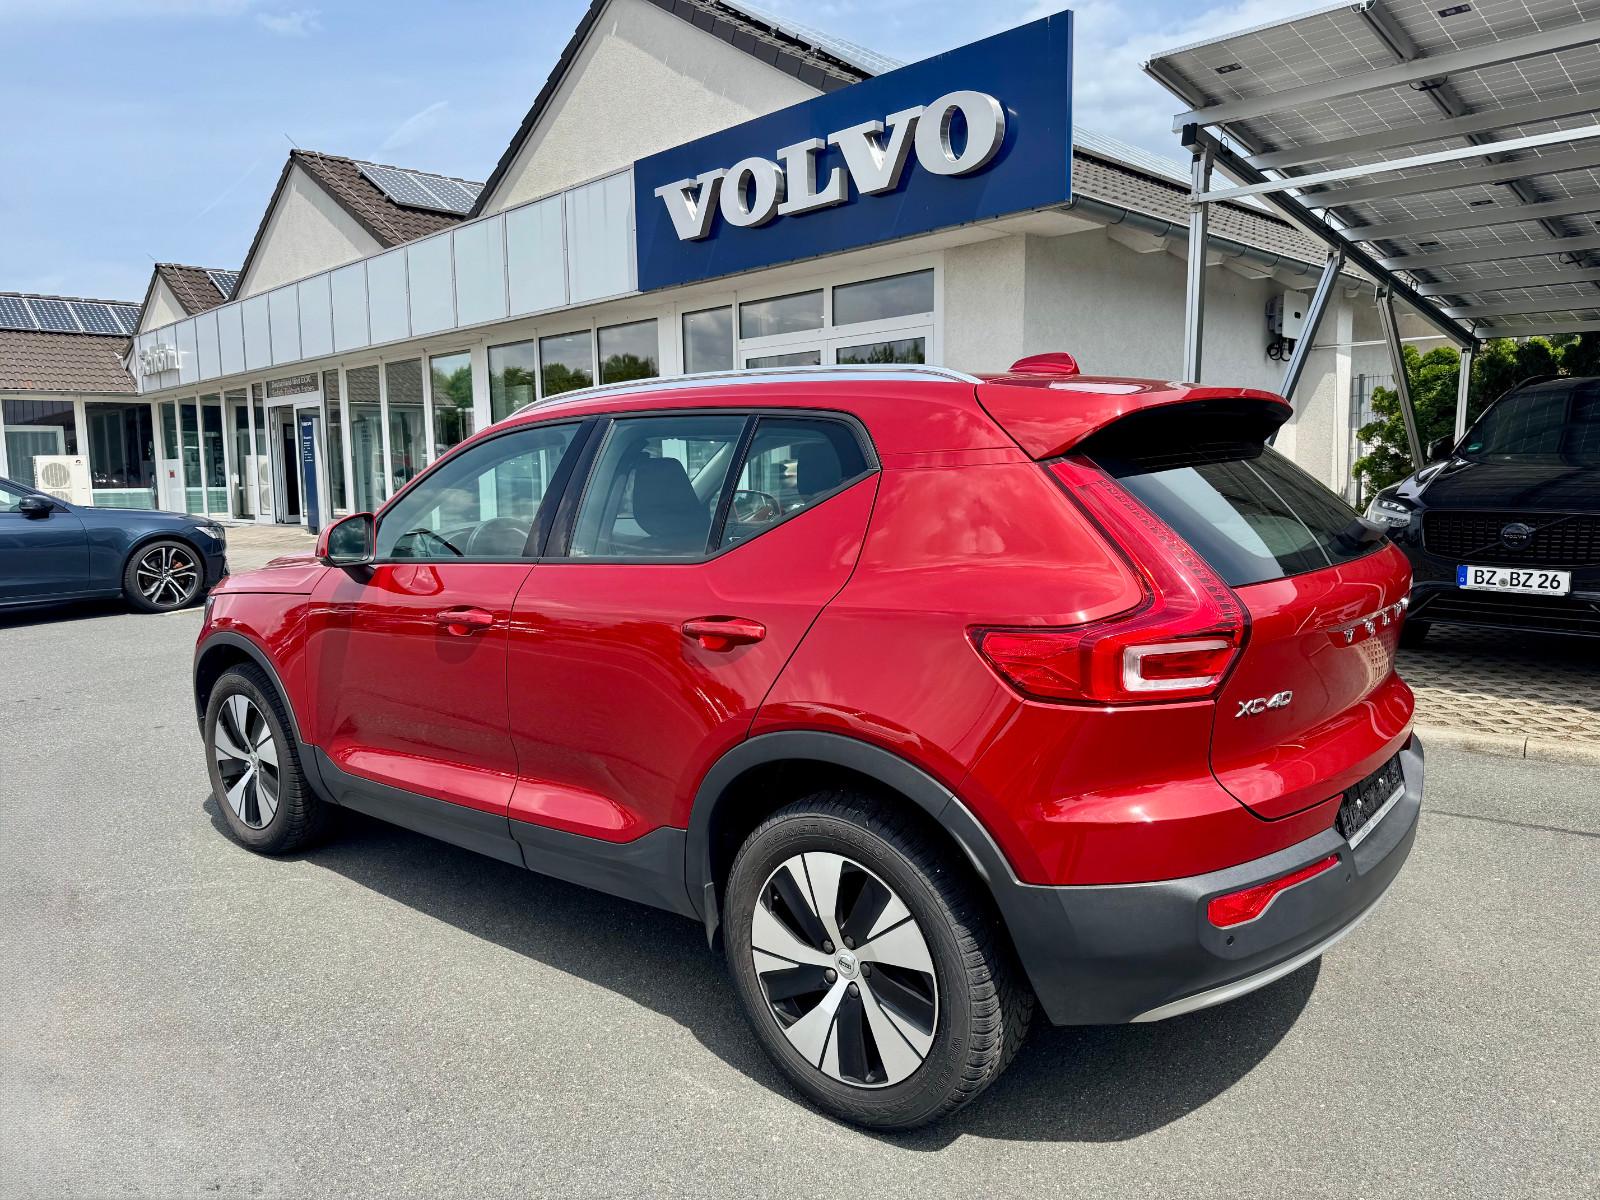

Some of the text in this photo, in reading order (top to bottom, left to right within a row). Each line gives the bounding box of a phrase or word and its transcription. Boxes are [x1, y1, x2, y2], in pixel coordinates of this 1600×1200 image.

[655, 90, 1005, 241] VOLVO
[1473, 569, 1561, 590] BZ BZ 26
[1235, 690, 1293, 718] XC40
